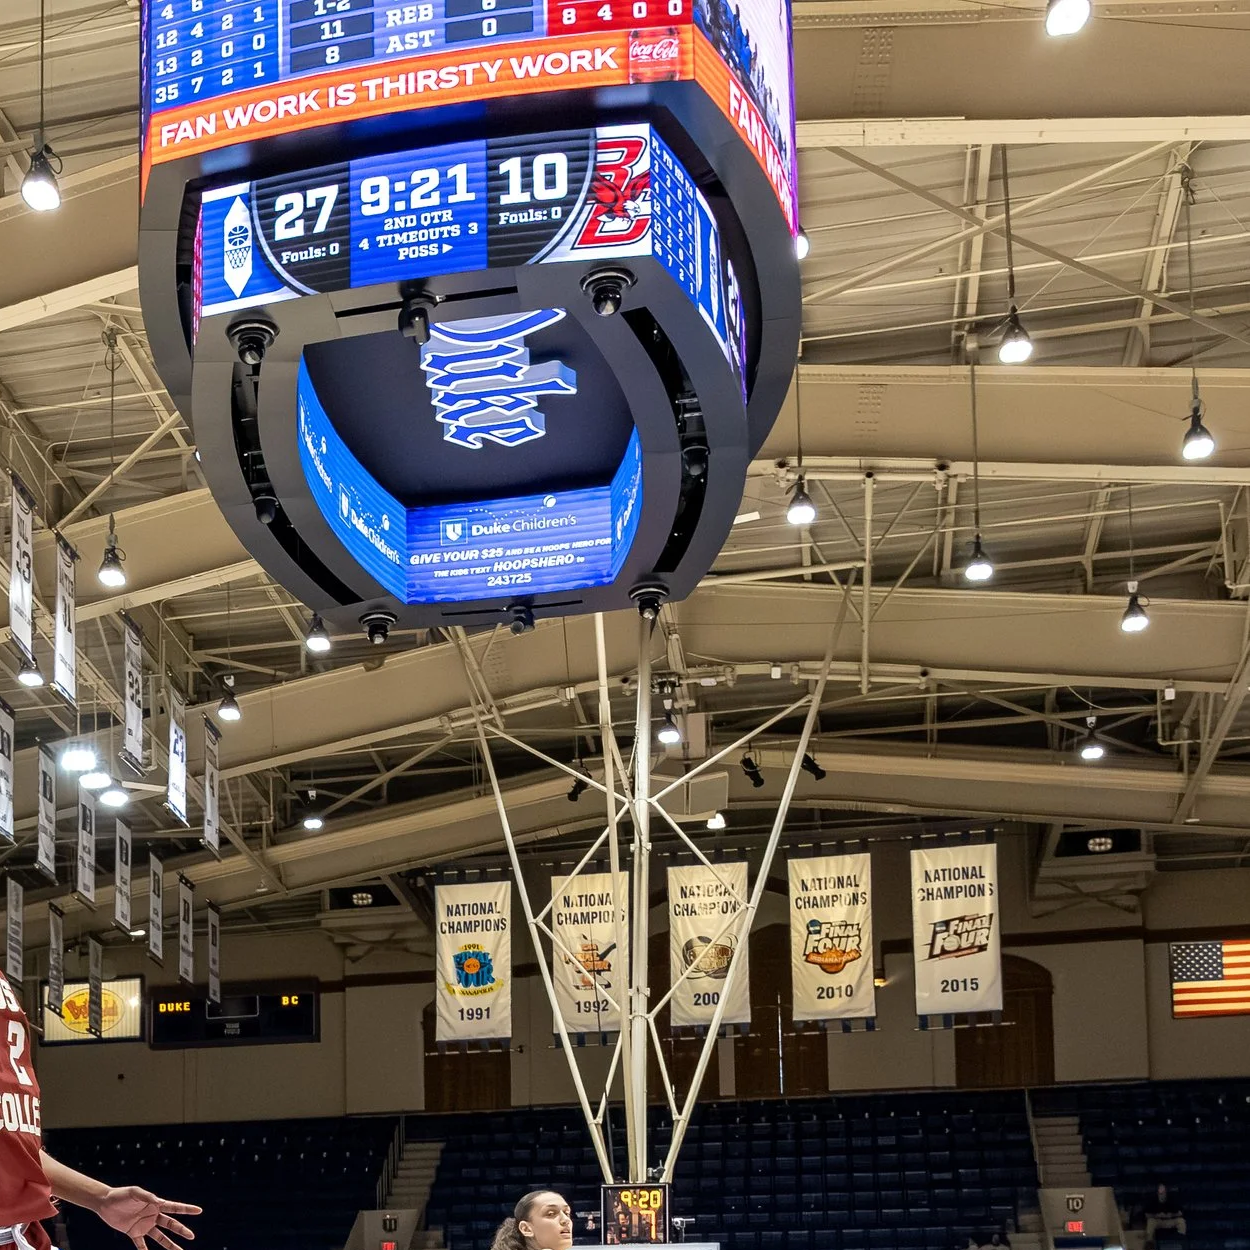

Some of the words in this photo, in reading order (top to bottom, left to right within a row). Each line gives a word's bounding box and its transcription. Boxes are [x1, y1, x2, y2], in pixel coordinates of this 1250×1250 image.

[161, 4, 173, 19] 4
[385, 4, 434, 28] REB
[562, 8, 576, 25] 8
[597, 4, 613, 21] 4
[632, 1, 647, 18] 0
[668, 0, 683, 16] 0
[156, 30, 178, 49] 12
[190, 22, 203, 38] 4
[221, 14, 234, 30] 2
[253, 7, 264, 22] 1
[320, 20, 345, 40] 11
[482, 18, 497, 36] 0
[386, 30, 435, 53] AST
[156, 57, 178, 76] 13
[191, 50, 203, 66] 2
[221, 41, 234, 57] 0
[252, 33, 265, 49] 0
[325, 46, 340, 64] 8
[155, 84, 179, 103] 35
[191, 76, 204, 93] 7
[221, 69, 234, 85] 2
[253, 62, 265, 77] 1
[161, 112, 217, 147] FAN
[222, 88, 321, 130] WORK
[328, 83, 356, 108] IS
[361, 59, 503, 101] THIRSTY
[508, 46, 618, 80] WORK
[729, 79, 763, 158] FAN
[360, 162, 476, 216] 9:21
[499, 152, 569, 207] 10
[274, 184, 339, 242] 27
[383, 212, 417, 232] 2ND
[419, 208, 454, 228] QTR
[498, 209, 548, 226] Fouls:
[551, 206, 562, 220] 0
[358, 237, 370, 251] 4
[376, 223, 461, 248] TIMEOUTS
[467, 222, 479, 235] 3
[281, 247, 327, 265] Fouls:
[330, 243, 340, 255] 0
[397, 242, 439, 261] POSS
[472, 520, 511, 537] Duke
[512, 513, 578, 533] Children's
[409, 552, 441, 566] GIVE
[442, 549, 479, 563] YOUR
[481, 546, 504, 560] $25
[572, 539, 594, 550] HERO
[595, 536, 612, 547] FOR
[434, 570, 449, 578] THE
[493, 553, 576, 573] HOOPSHERO
[487, 573, 532, 588] 243725
[800, 874, 860, 892] NATIONAL
[924, 865, 986, 883] NATIONAL
[563, 891, 613, 908] NATIONA
[680, 883, 736, 899] NATIONAL
[795, 892, 867, 910] CHAMPIONS
[917, 882, 994, 902] CHAMPIONS
[446, 901, 501, 917] NATIONAL
[673, 901, 742, 917] CHAMPIONS
[440, 917, 507, 935] CHAMPIONS
[820, 923, 861, 938] FINAL
[949, 915, 991, 933] FINAL
[806, 935, 862, 955] FOUR
[933, 929, 989, 955] FOUR
[816, 984, 854, 1000] 2010
[941, 977, 979, 993] 2015
[158, 1002, 191, 1013] DUKE
[282, 995, 299, 1006] BC
[575, 999, 609, 1014] 1992
[693, 992, 720, 1006] 200
[458, 1006, 491, 1021] 1991
[7, 1019, 33, 1086] 2
[620, 1189, 661, 1209] 9:20
[1069, 1198, 1082, 1210] 10
[640, 1210, 657, 1240] 7
